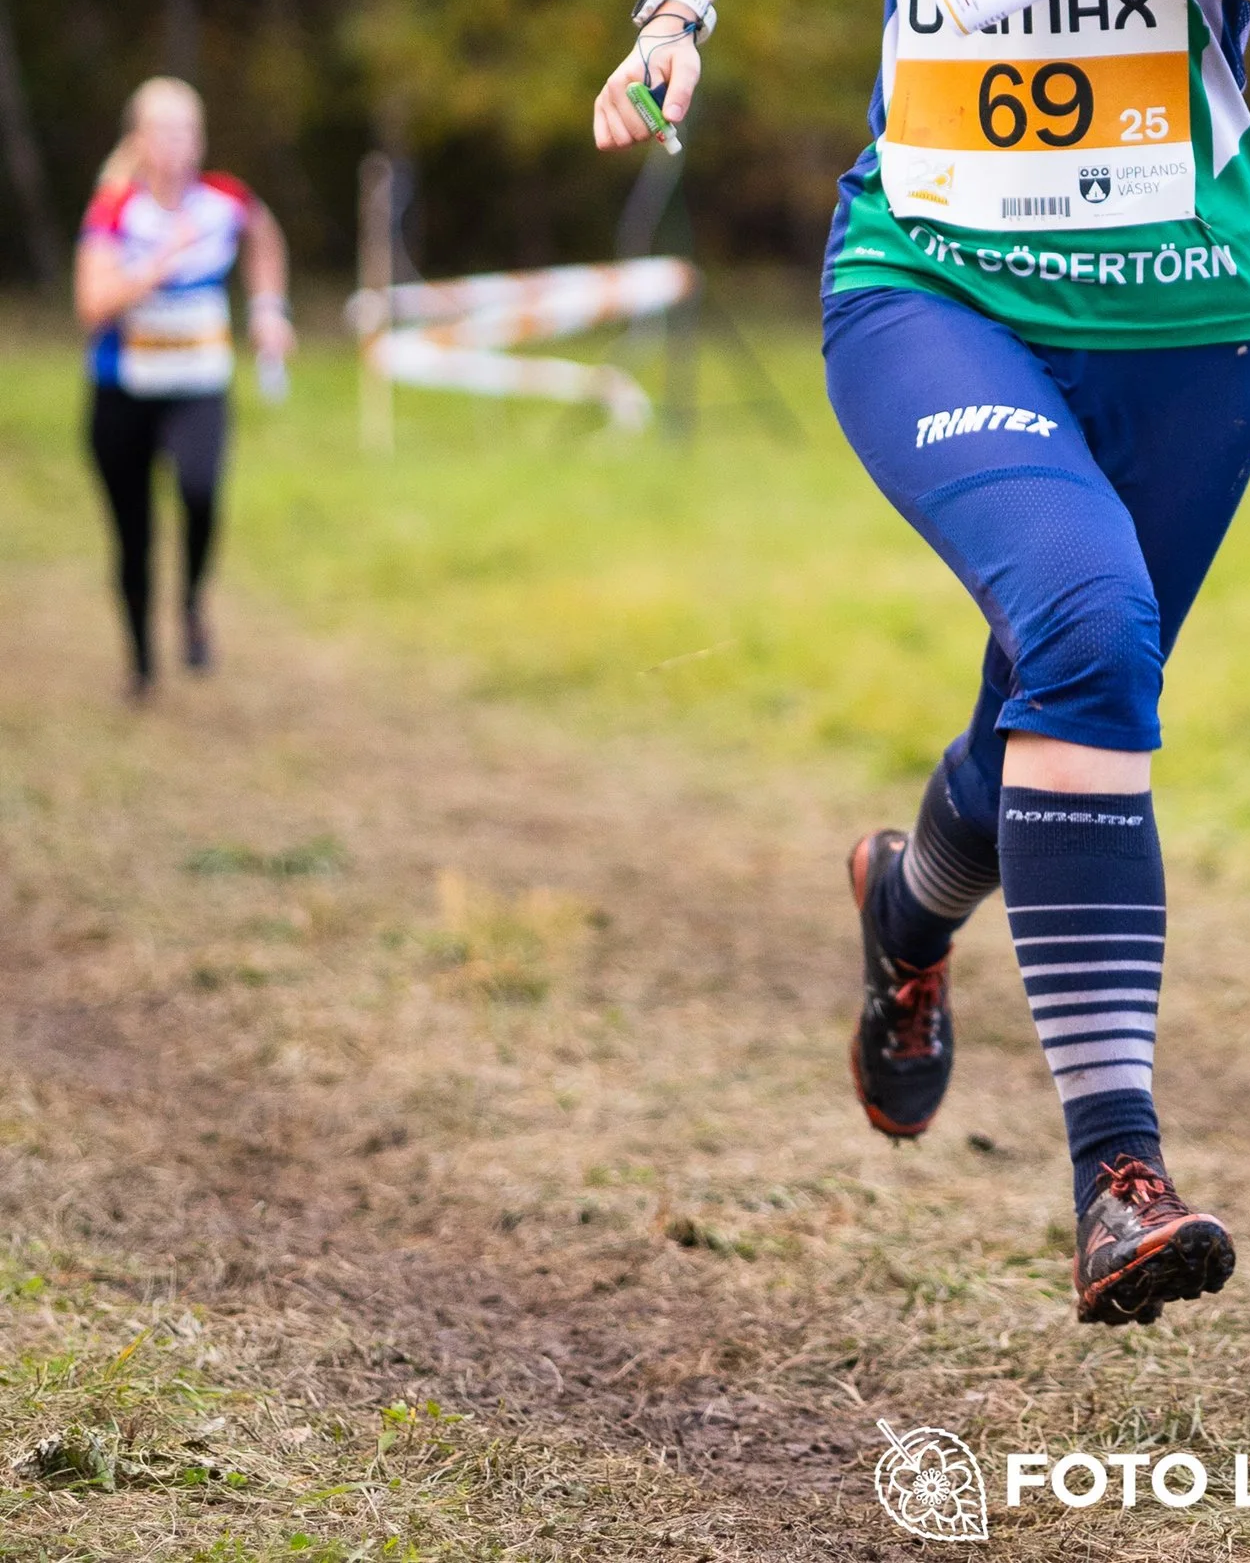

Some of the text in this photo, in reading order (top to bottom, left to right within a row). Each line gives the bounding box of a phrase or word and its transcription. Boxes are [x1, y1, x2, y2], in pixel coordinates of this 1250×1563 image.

[978, 61, 1094, 148] 69
[1119, 106, 1169, 141] 25
[1116, 161, 1188, 180] UPPLANDS
[1117, 180, 1161, 197] VÄSBY
[976, 244, 1238, 285] SÖDERTÖRN
[915, 404, 1059, 449] TRIMTEX
